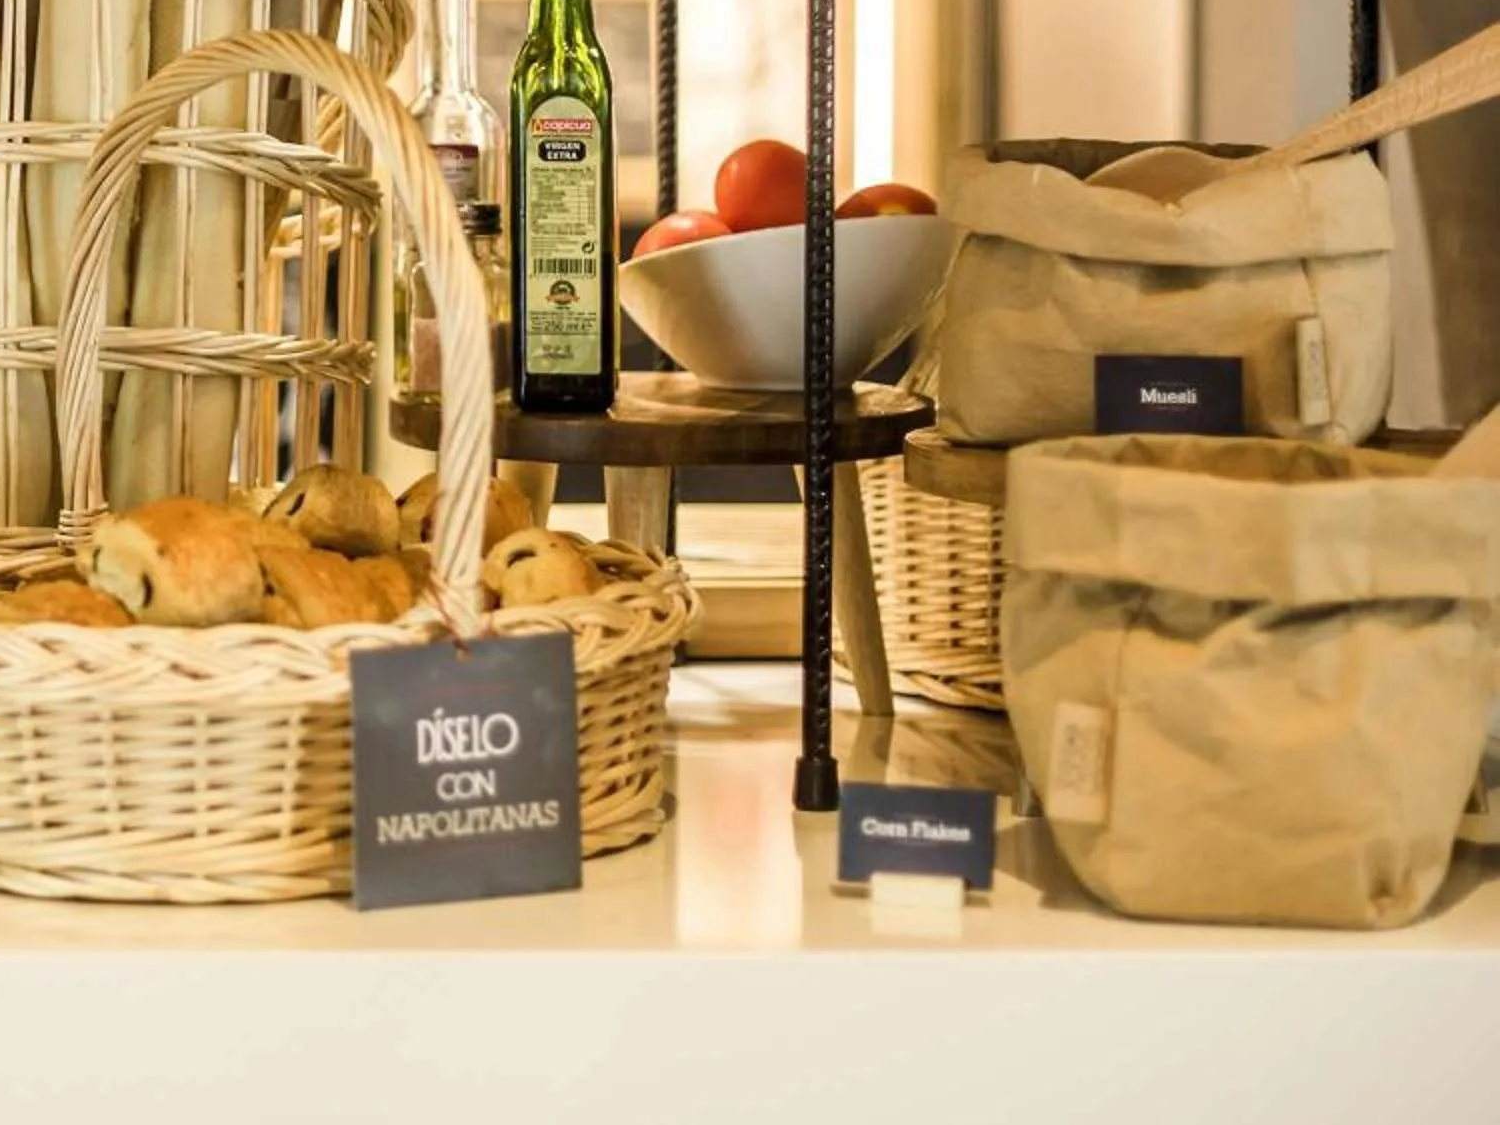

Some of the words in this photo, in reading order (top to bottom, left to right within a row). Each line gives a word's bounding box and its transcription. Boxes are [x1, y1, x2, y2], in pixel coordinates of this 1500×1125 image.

[1140, 387, 1197, 404] Muesli
[436, 769, 496, 801] CON
[377, 800, 559, 844] NAPOLITANAS
[860, 816, 907, 838] Corn
